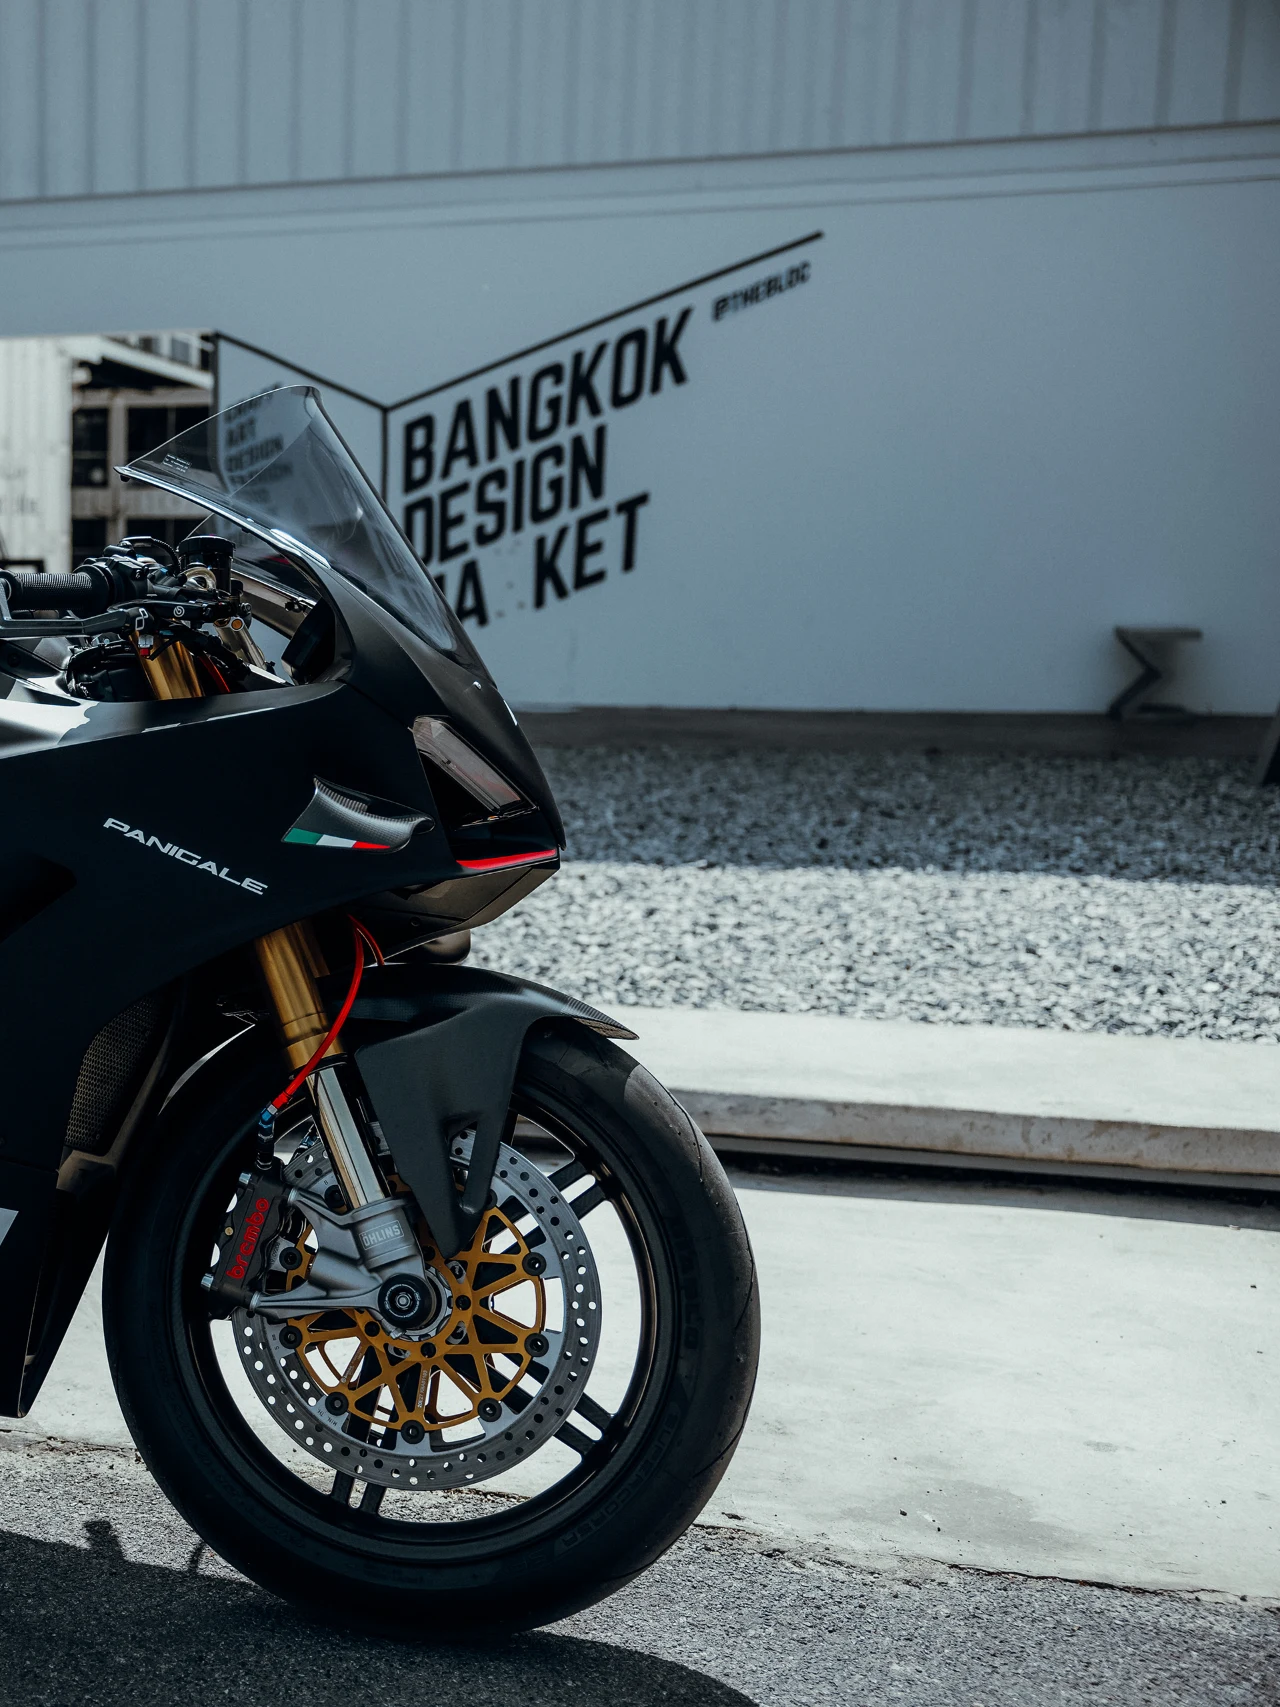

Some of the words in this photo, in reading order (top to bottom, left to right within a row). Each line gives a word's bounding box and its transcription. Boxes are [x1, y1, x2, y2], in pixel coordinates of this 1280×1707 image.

[403, 303, 694, 495] BANGKOK
[403, 423, 608, 567] DESIGN
[103, 817, 268, 895] PANIGALE
[226, 1197, 269, 1279] brembo
[361, 1225, 400, 1247] ÖHLINS
